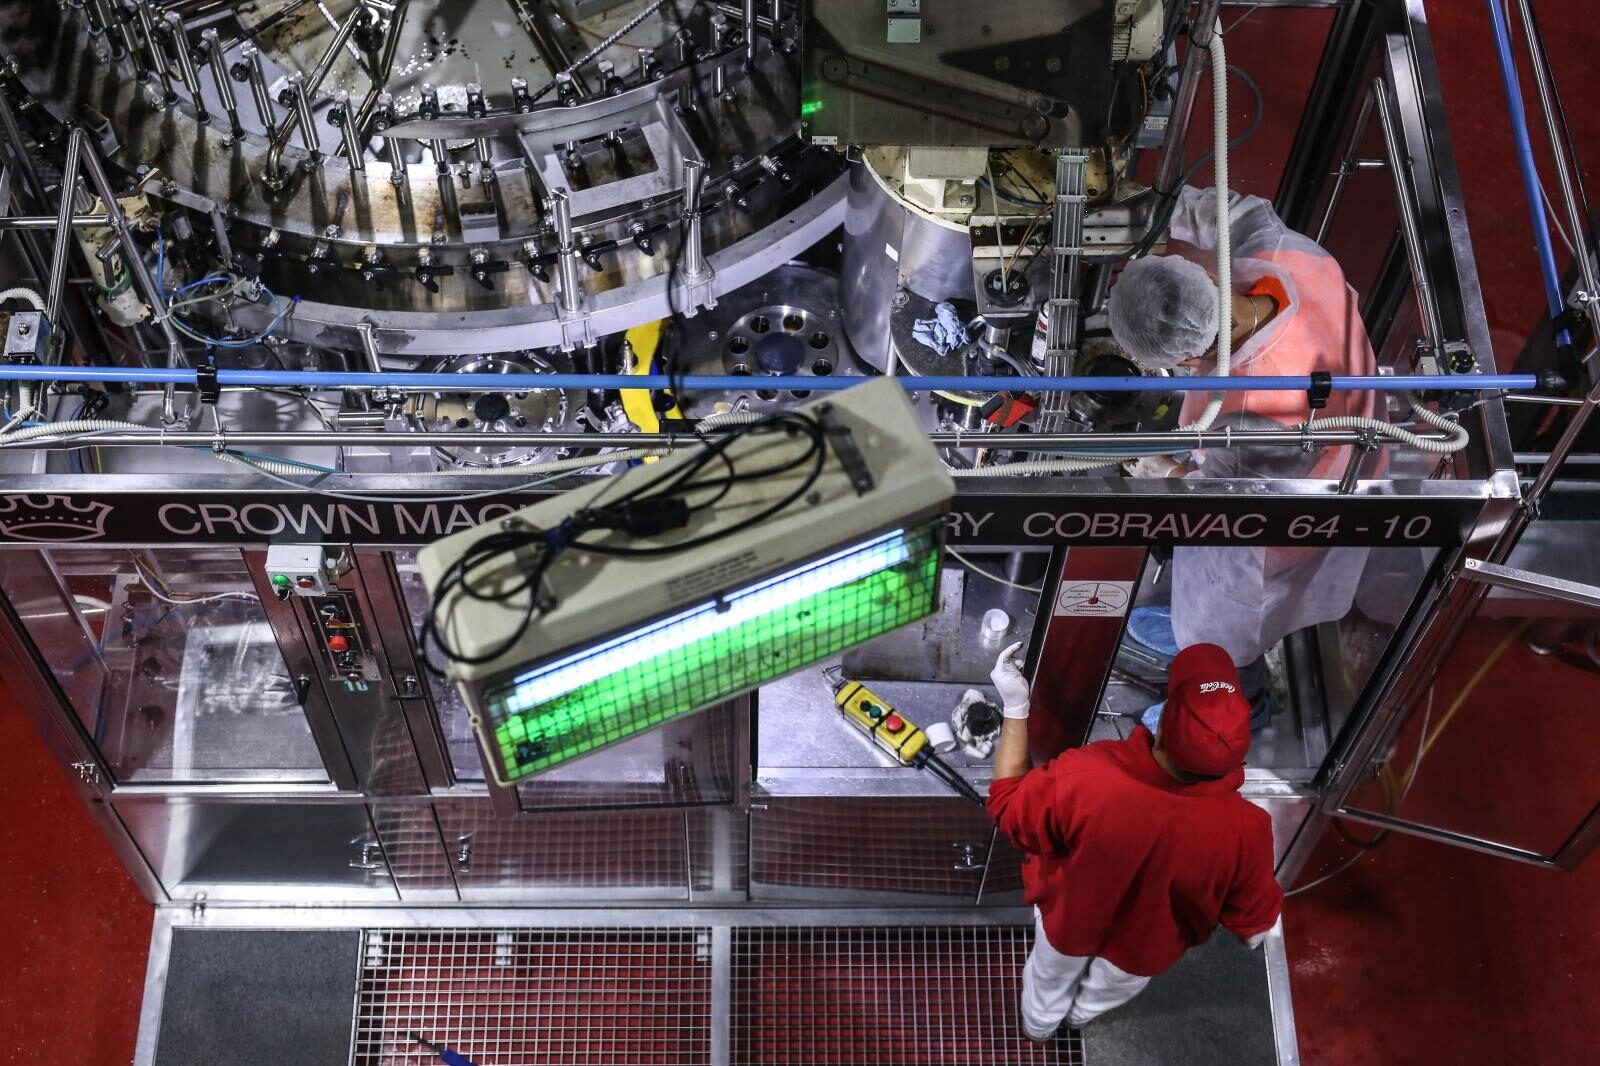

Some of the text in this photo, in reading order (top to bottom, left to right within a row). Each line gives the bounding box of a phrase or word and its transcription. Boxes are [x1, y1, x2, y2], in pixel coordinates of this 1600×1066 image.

[157, 503, 381, 535] CROWN
[395, 503, 528, 535] MA
[1022, 512, 1268, 539] COBRAVAC
[1287, 514, 1341, 539] 64
[1383, 515, 1432, 539] 10
